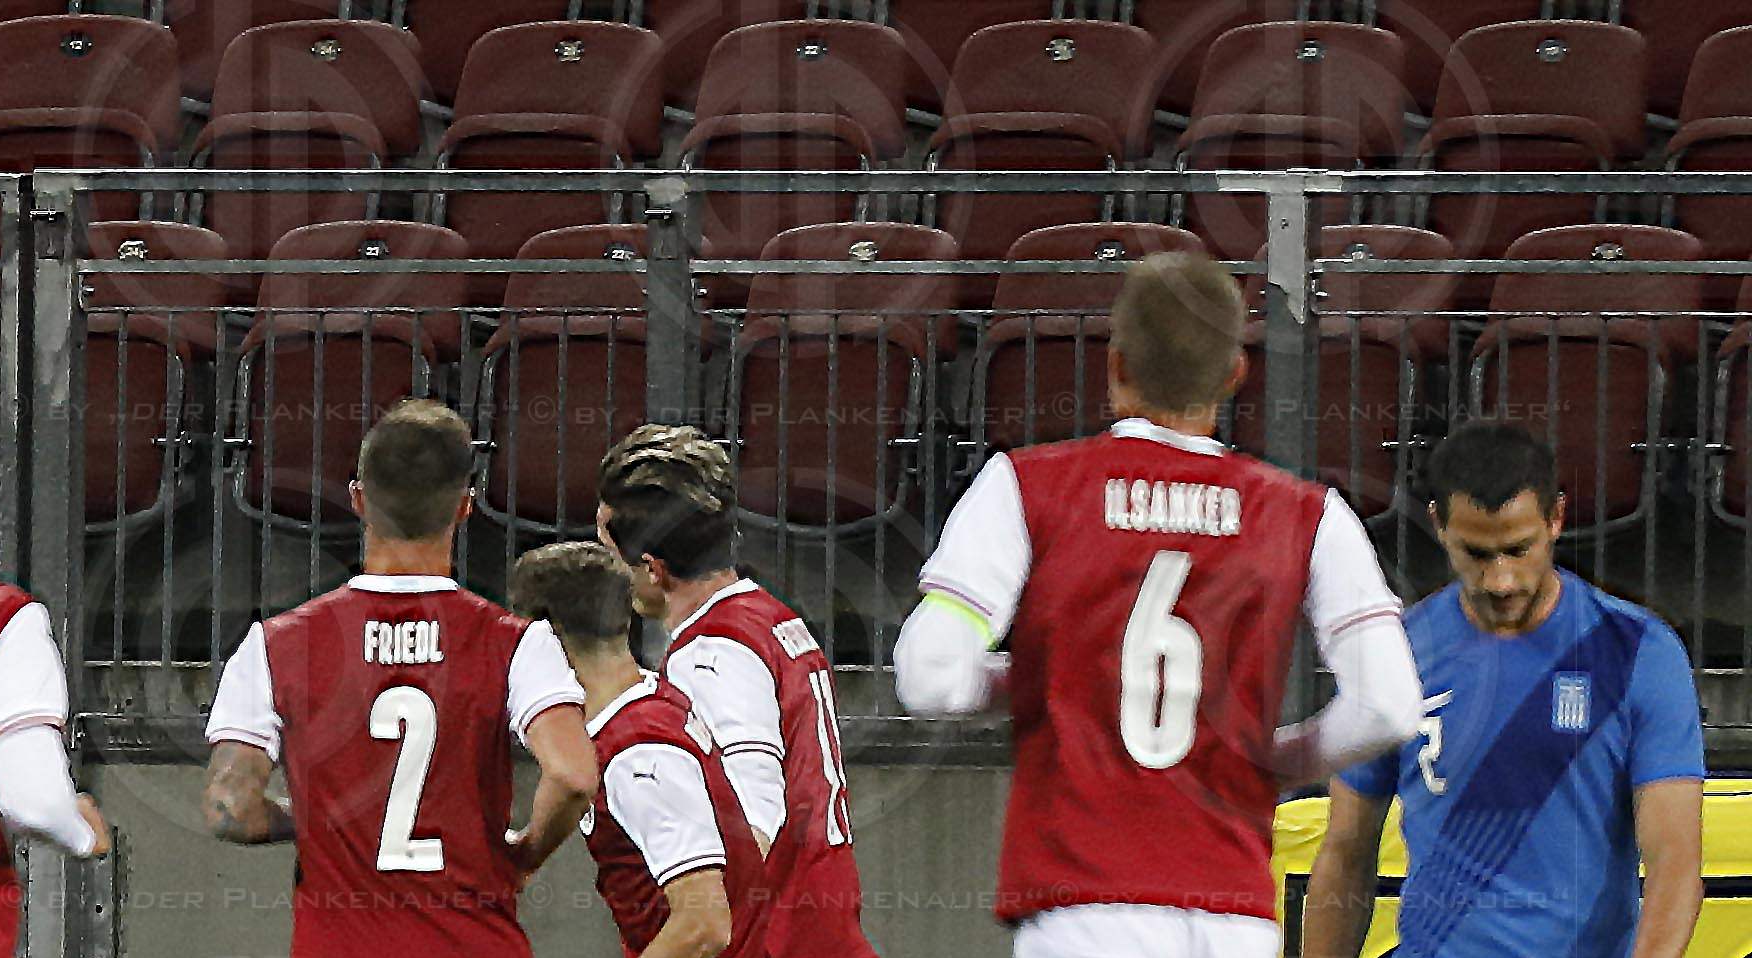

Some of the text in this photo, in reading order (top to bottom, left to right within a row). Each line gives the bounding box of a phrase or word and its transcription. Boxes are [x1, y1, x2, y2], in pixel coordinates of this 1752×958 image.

[364, 620, 445, 665] FRIEDL
[1119, 549, 1204, 769] 6
[369, 685, 445, 872] 2
